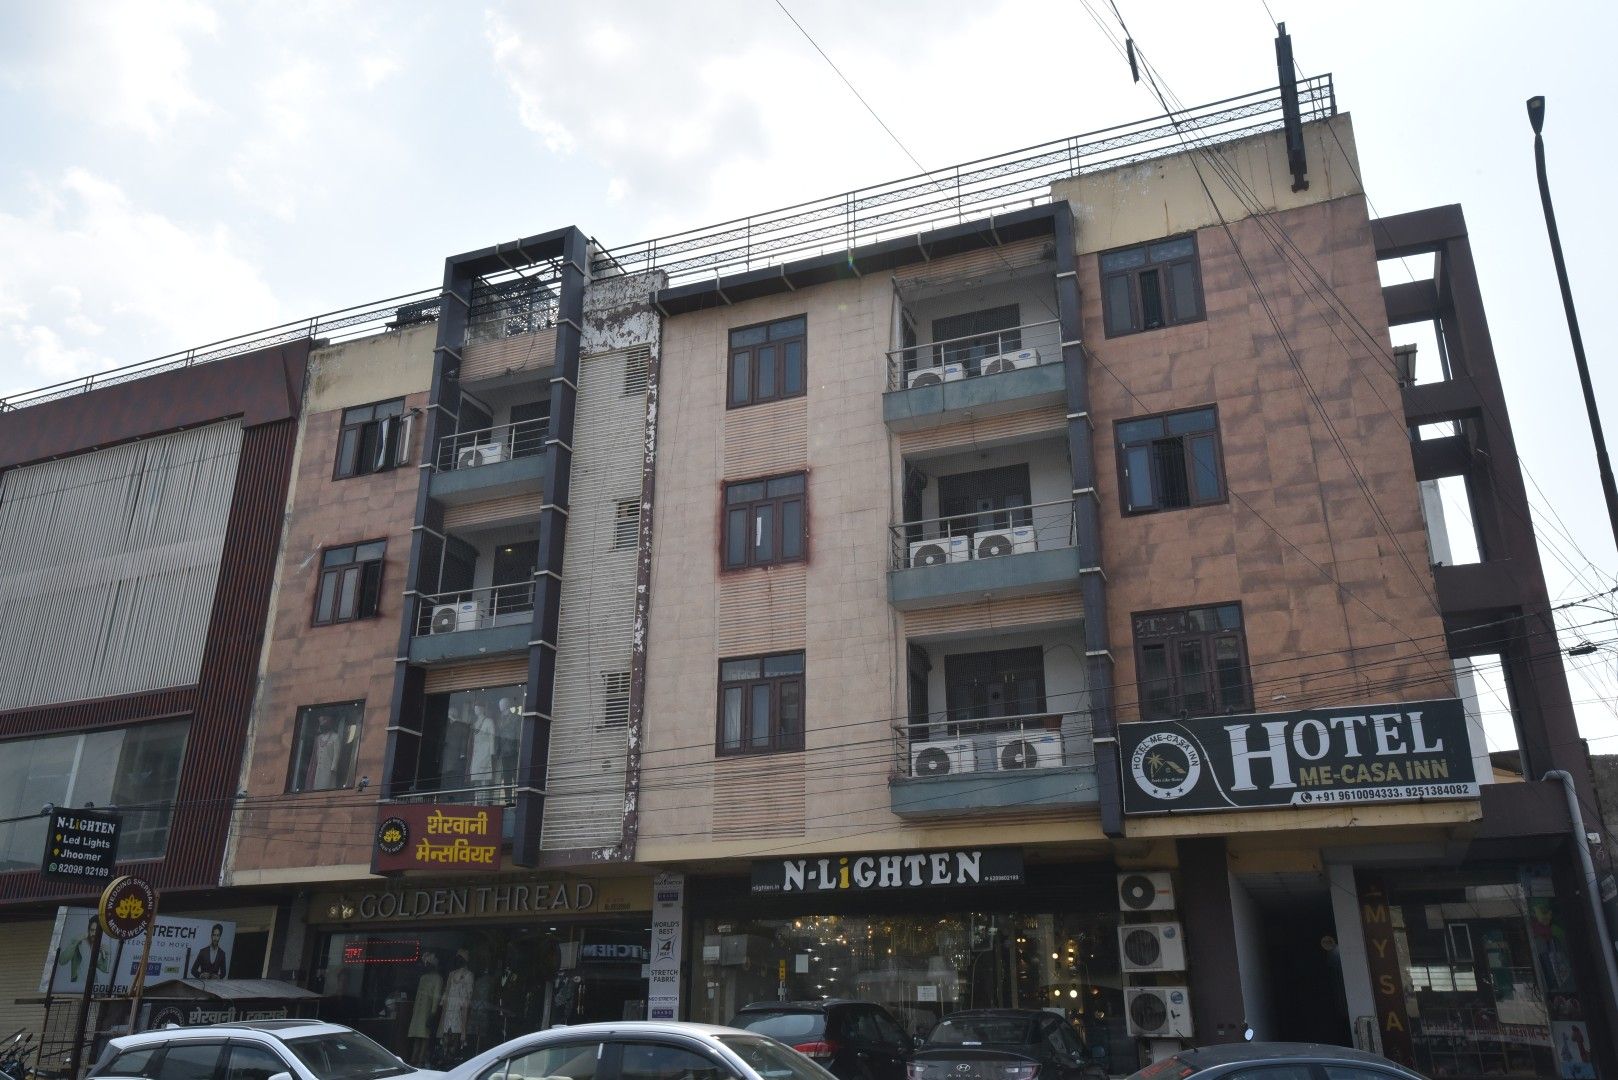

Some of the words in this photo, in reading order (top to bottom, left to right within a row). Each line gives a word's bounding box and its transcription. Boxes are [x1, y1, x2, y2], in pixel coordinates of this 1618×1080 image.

[1133, 742, 1151, 770] HOTEL
[1150, 734, 1191, 752] ME-CASA
[1188, 751, 1199, 767] INN
[1223, 711, 1443, 792] HOTEL
[1300, 761, 1402, 786] ME-CASA
[1405, 758, 1449, 781] INN
[1316, 791, 1335, 802] +91
[1339, 788, 1403, 801] 9610094333,
[1406, 784, 1469, 798] 9251384082
[427, 809, 488, 834] शेरवानी
[63, 834, 80, 845] Led
[83, 837, 111, 849] Lights
[416, 838, 496, 863] मेन्सवियर
[61, 849, 101, 861] Jhoomer
[58, 863, 83, 875] 82098
[85, 866, 109, 877] 02189
[108, 879, 132, 910] WEDDING
[133, 878, 153, 910] SHERWANI
[360, 889, 468, 919] GOLDEN
[476, 883, 594, 914] THREAD
[127, 920, 148, 938] WEAR
[661, 941, 672, 951] 4
